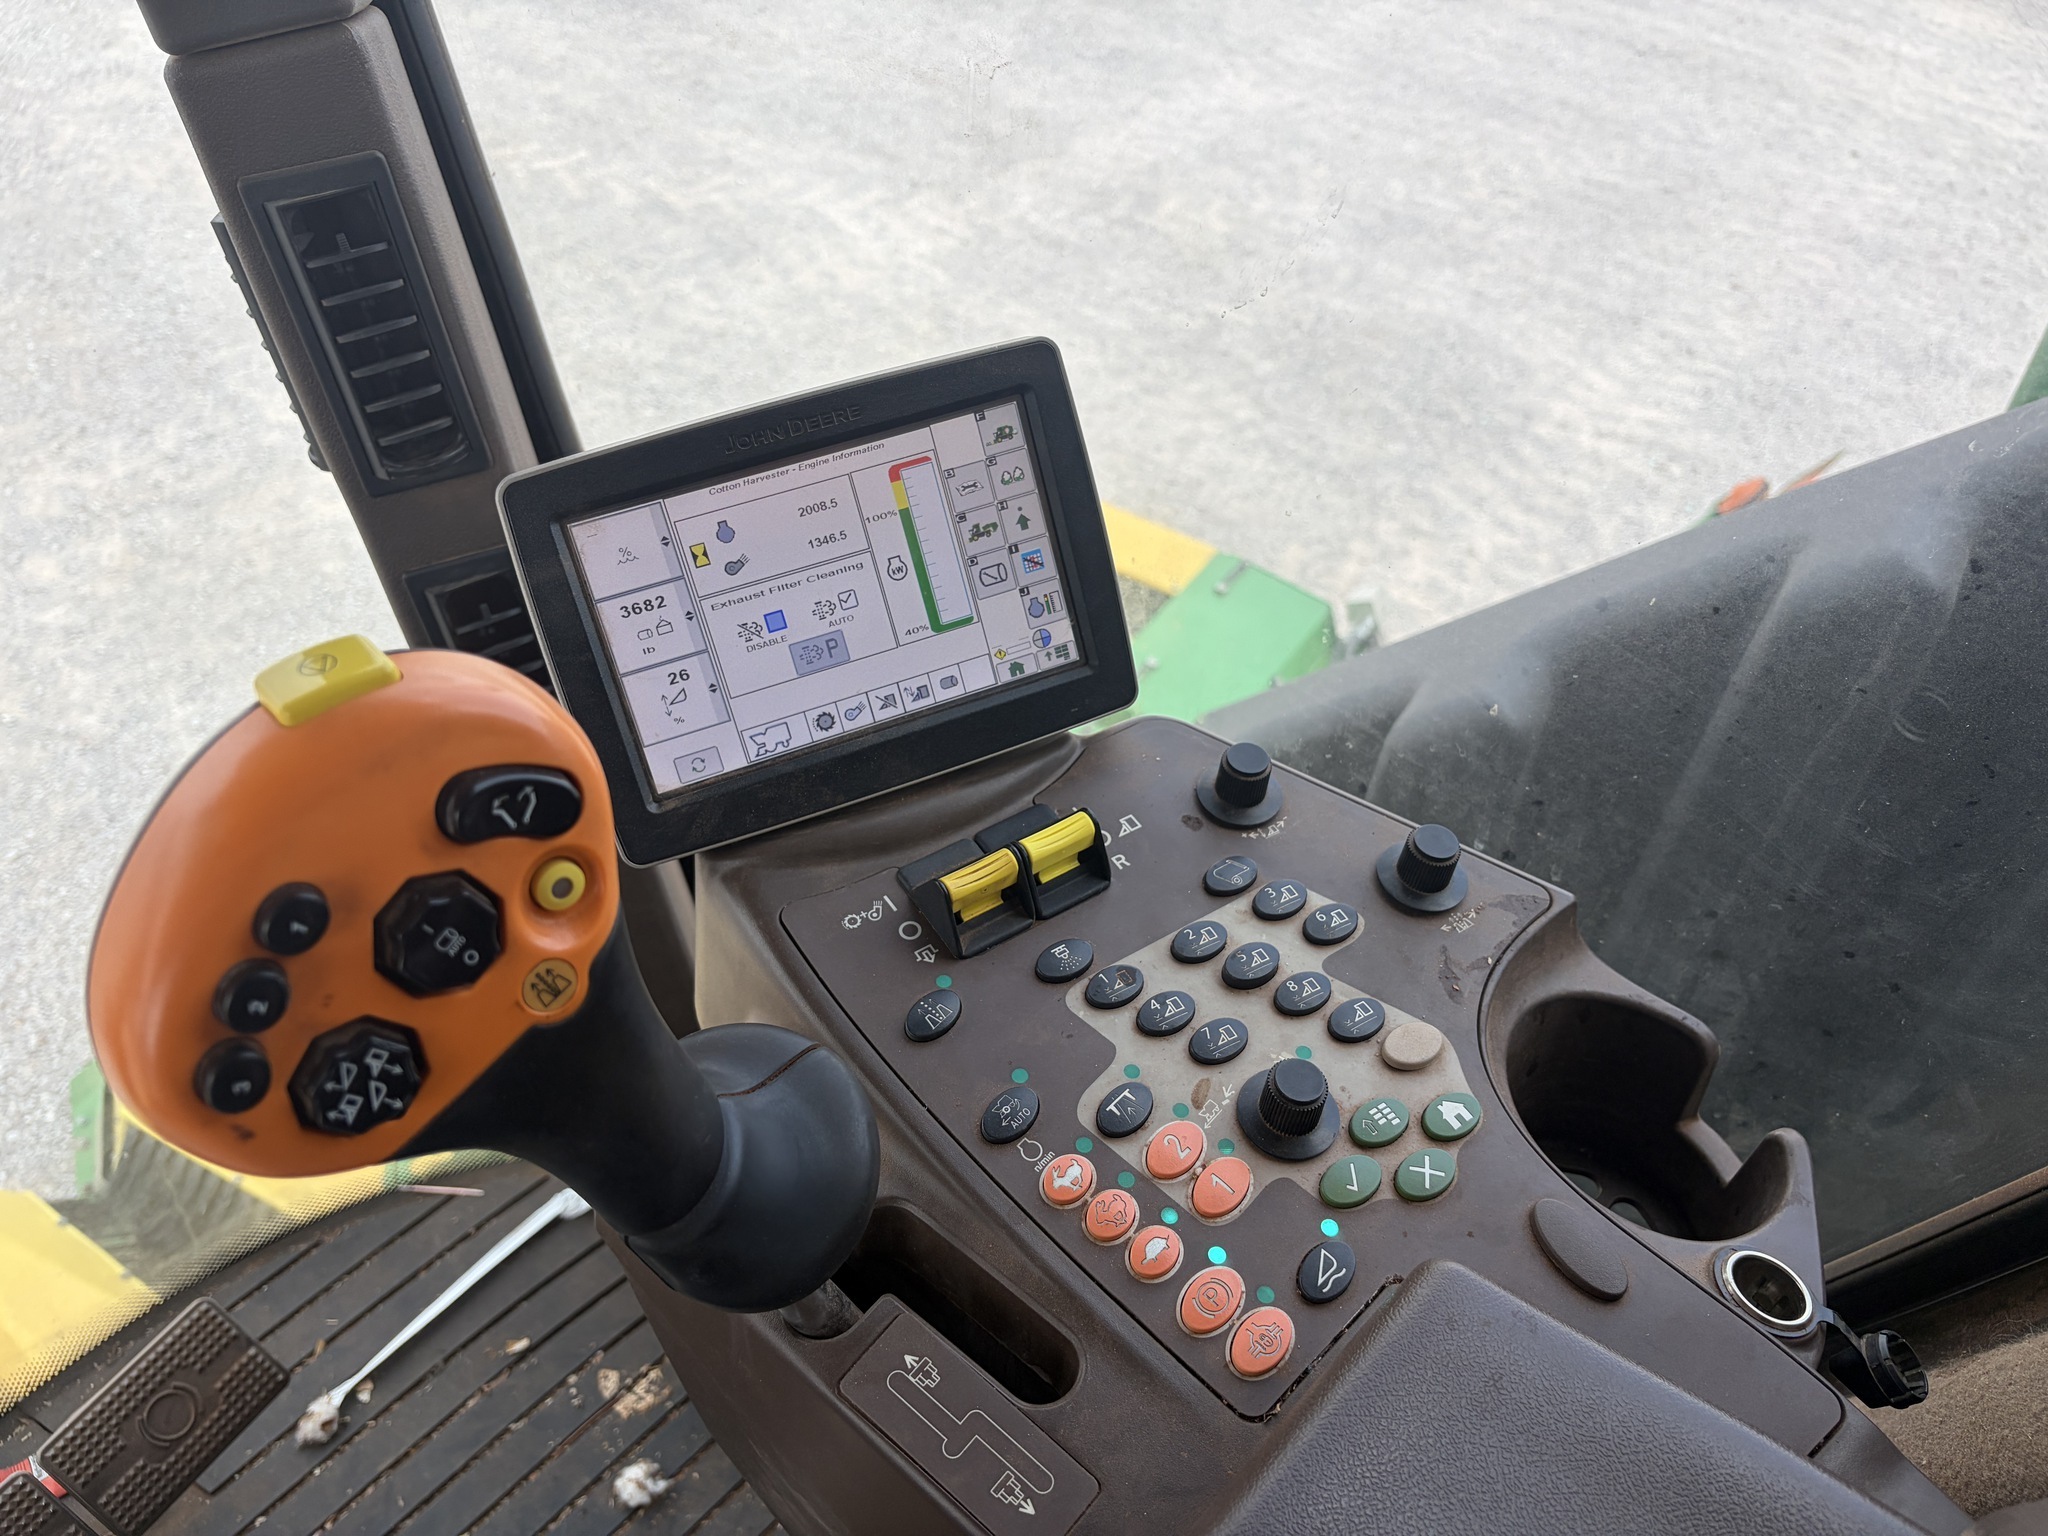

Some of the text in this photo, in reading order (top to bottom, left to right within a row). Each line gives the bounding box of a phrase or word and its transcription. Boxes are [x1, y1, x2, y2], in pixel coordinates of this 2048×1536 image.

[725, 407, 862, 454] JOHN DEERE
[709, 482, 741, 496] Cotton
[743, 468, 790, 486] Harvester
[799, 459, 830, 474] Engine
[832, 442, 885, 463] Information
[798, 498, 838, 517] 2008.5
[865, 509, 898, 524] 100%
[808, 530, 847, 549] 1346.5
[891, 565, 904, 576] kW
[711, 561, 864, 611] Exhaust Filter Cleaning
[620, 595, 667, 618] 3682
[828, 614, 855, 628] AUTO
[905, 624, 930, 636] 40%
[746, 635, 788, 653] DISABLE
[825, 637, 839, 659] P
[667, 669, 691, 686] 26
[1111, 853, 1131, 870] R
[1264, 887, 1276, 898] 3
[1315, 911, 1327, 922] 6
[1183, 929, 1196, 940] 2
[1236, 951, 1247, 963] 5
[1098, 973, 1109, 984] 1
[1286, 980, 1298, 992] 8
[247, 1000, 269, 1016] 2
[1150, 999, 1161, 1011] 4
[1200, 1027, 1211, 1039] 7
[1010, 1107, 1032, 1129] AUTO
[1163, 1133, 1192, 1160] 2
[1034, 1149, 1056, 1173] n/min
[1211, 1172, 1236, 1195] 1
[1203, 1286, 1220, 1307] P
